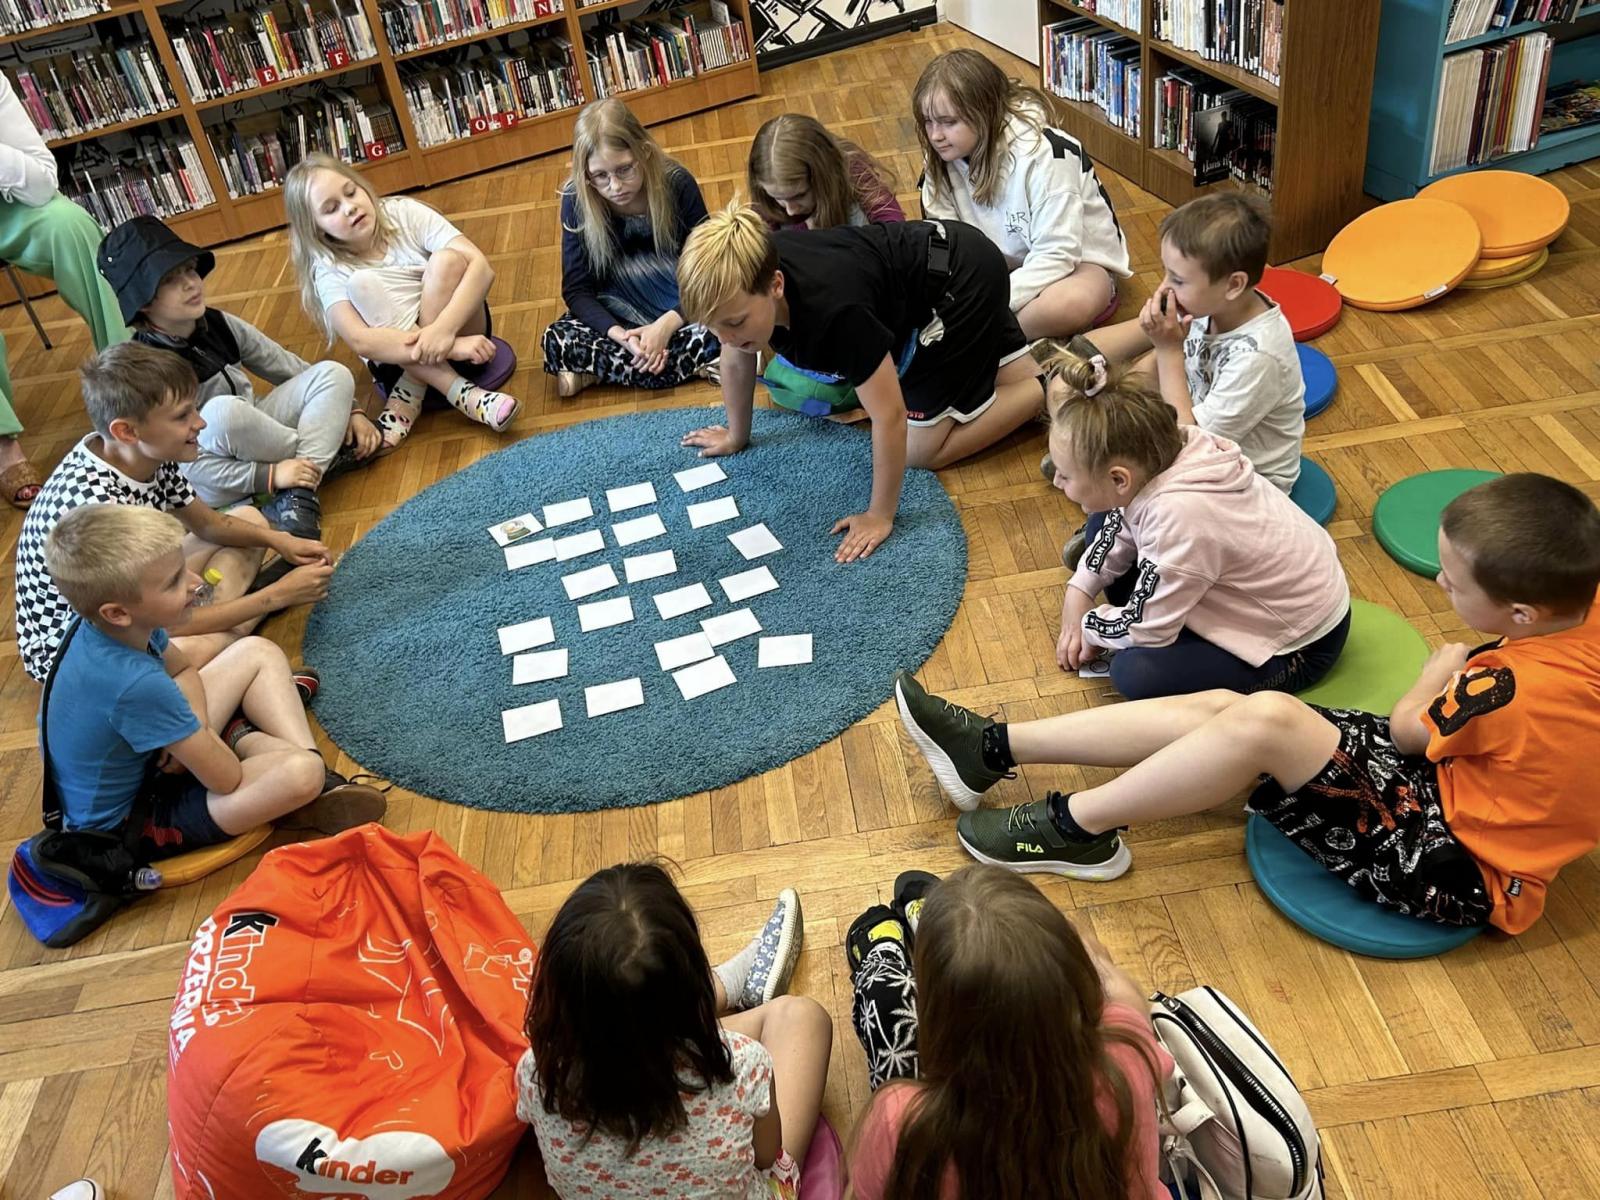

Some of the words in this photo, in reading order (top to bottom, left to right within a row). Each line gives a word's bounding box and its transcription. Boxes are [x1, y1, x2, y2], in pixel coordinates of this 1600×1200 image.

[537, 1, 550, 14] N
[334, 52, 344, 66] F
[263, 69, 276, 83] E
[474, 119, 487, 131] O
[506, 113, 515, 126] P
[371, 144, 383, 157] G
[1015, 842, 1045, 854] FILA
